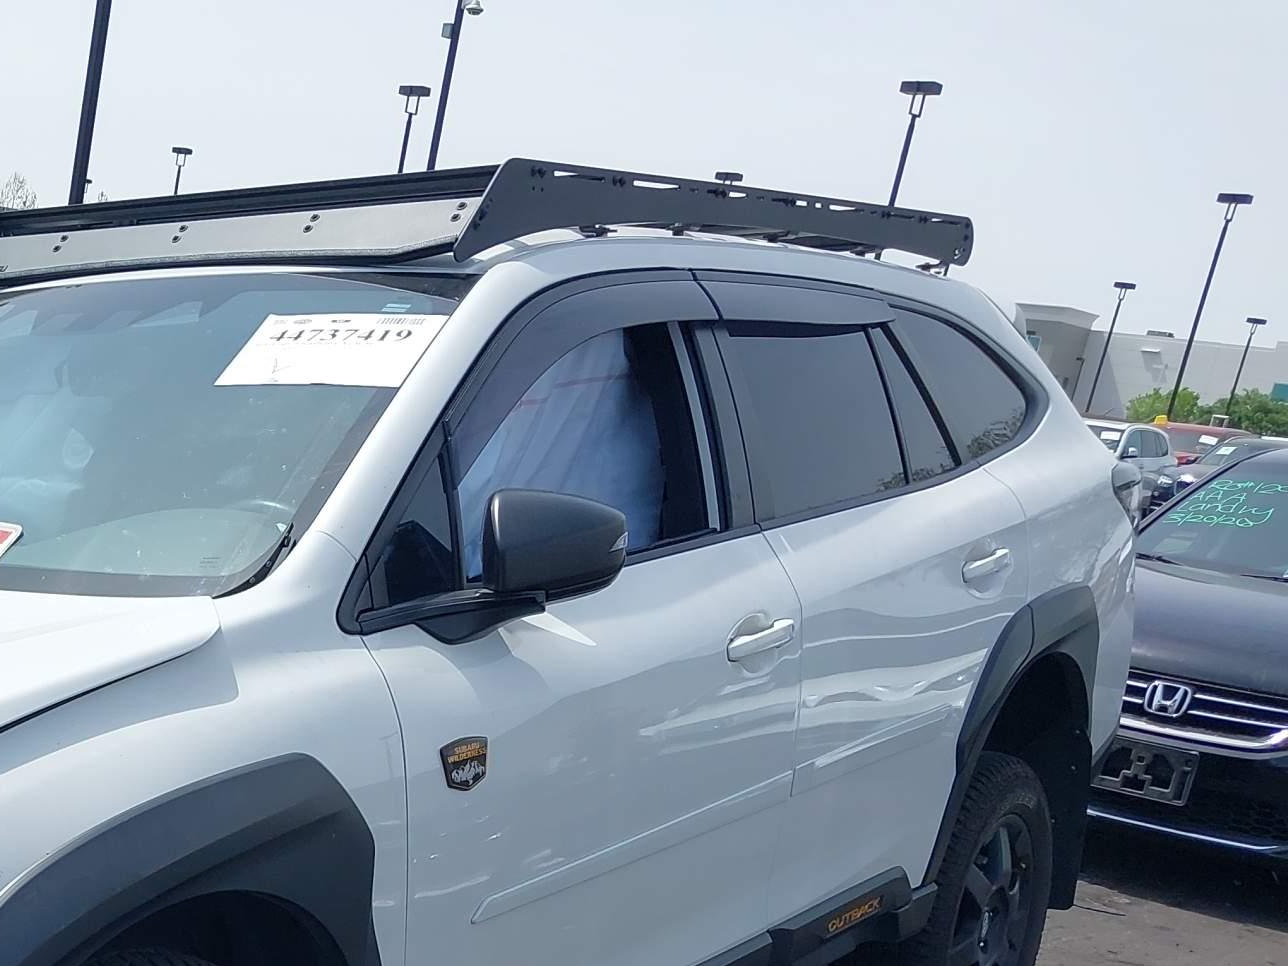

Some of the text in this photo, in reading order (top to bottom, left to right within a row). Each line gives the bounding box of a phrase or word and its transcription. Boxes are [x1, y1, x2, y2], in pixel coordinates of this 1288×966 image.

[269, 328, 413, 342] 44737419
[447, 747, 486, 764] WILDERNESS
[454, 742, 480, 754] SUBARU
[828, 896, 881, 932] OUTBACK
